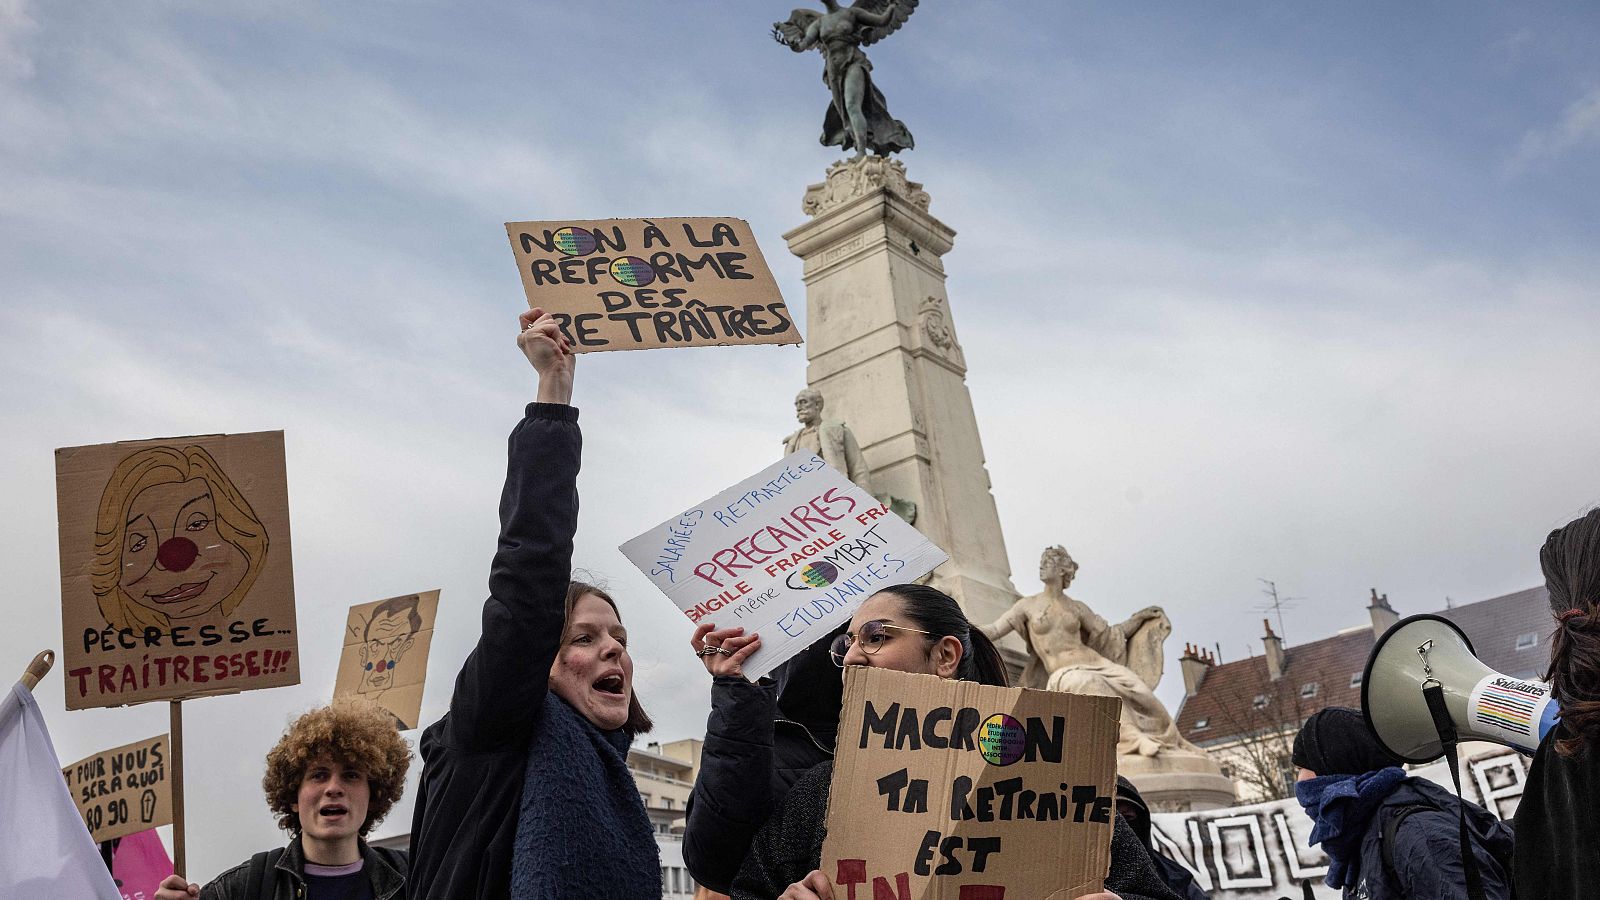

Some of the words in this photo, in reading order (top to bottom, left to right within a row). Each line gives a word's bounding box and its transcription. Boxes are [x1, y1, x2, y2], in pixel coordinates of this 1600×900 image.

[519, 225, 626, 256] NON
[642, 219, 670, 248] À
[682, 222, 740, 248] LA
[531, 252, 754, 287] RÉFORME
[597, 289, 687, 311] DES
[694, 487, 857, 588] PRECAIRES
[764, 528, 846, 577] FRAGILE
[785, 522, 888, 590] COMBAT
[858, 700, 1065, 766] MACRON
[77, 756, 106, 785] POUR
[111, 742, 163, 776] NOUS
[82, 775, 122, 804] SERA
[876, 767, 929, 813] TA
[86, 804, 103, 834] 80
[107, 798, 128, 826] 90
[914, 829, 1002, 876] EST
